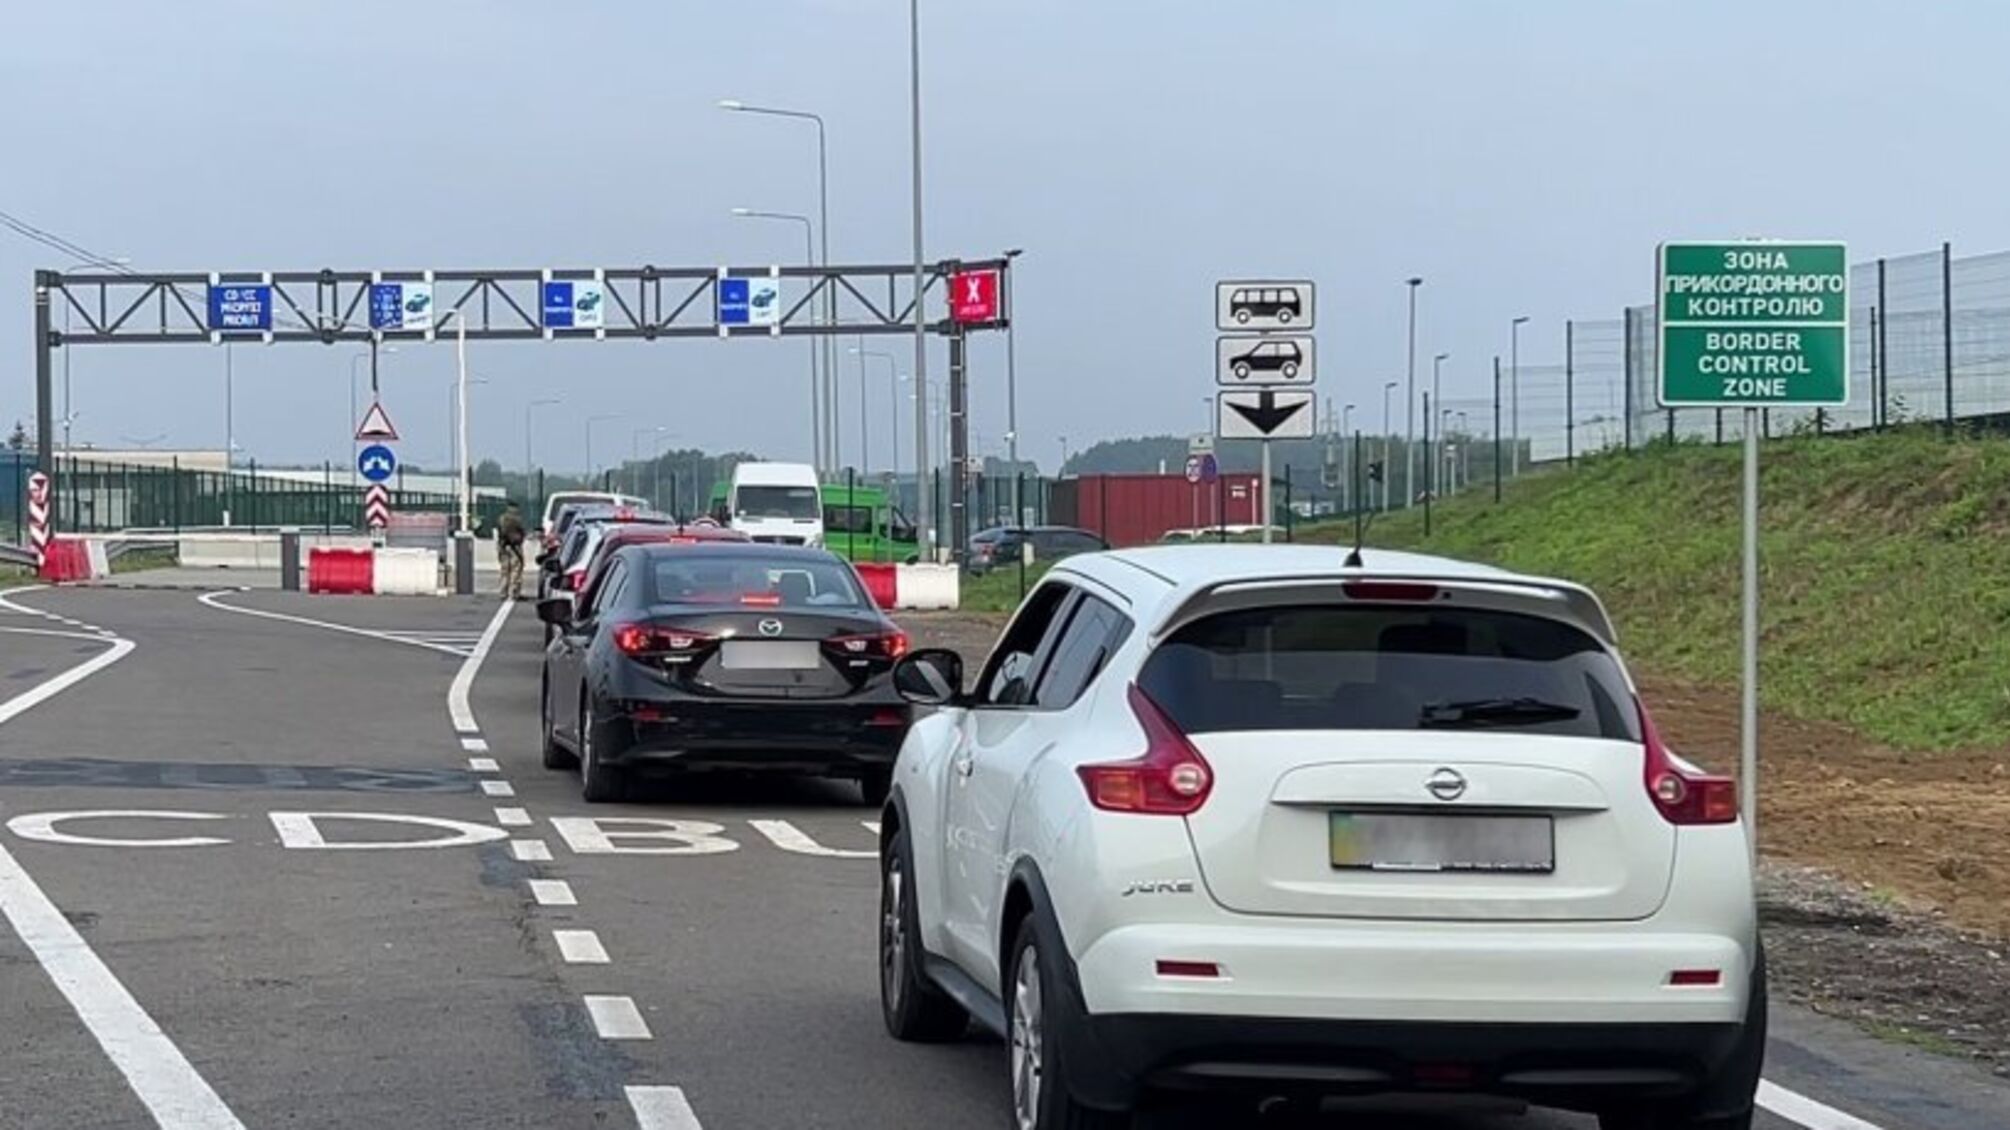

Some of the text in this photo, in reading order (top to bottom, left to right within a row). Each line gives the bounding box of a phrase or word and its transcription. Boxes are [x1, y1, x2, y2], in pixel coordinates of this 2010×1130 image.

[1724, 252, 1788, 269] ЗОНА
[1665, 274, 1843, 295] ПРИКОРДОННОГО
[1688, 298, 1824, 315] КОНТРОЛЮ
[1706, 333, 1801, 350] BORDER
[1698, 356, 1811, 373] CONTROL
[1723, 379, 1787, 396] ZONE
[6, 810, 509, 849] CD
[1121, 881, 1195, 898] JUKE
